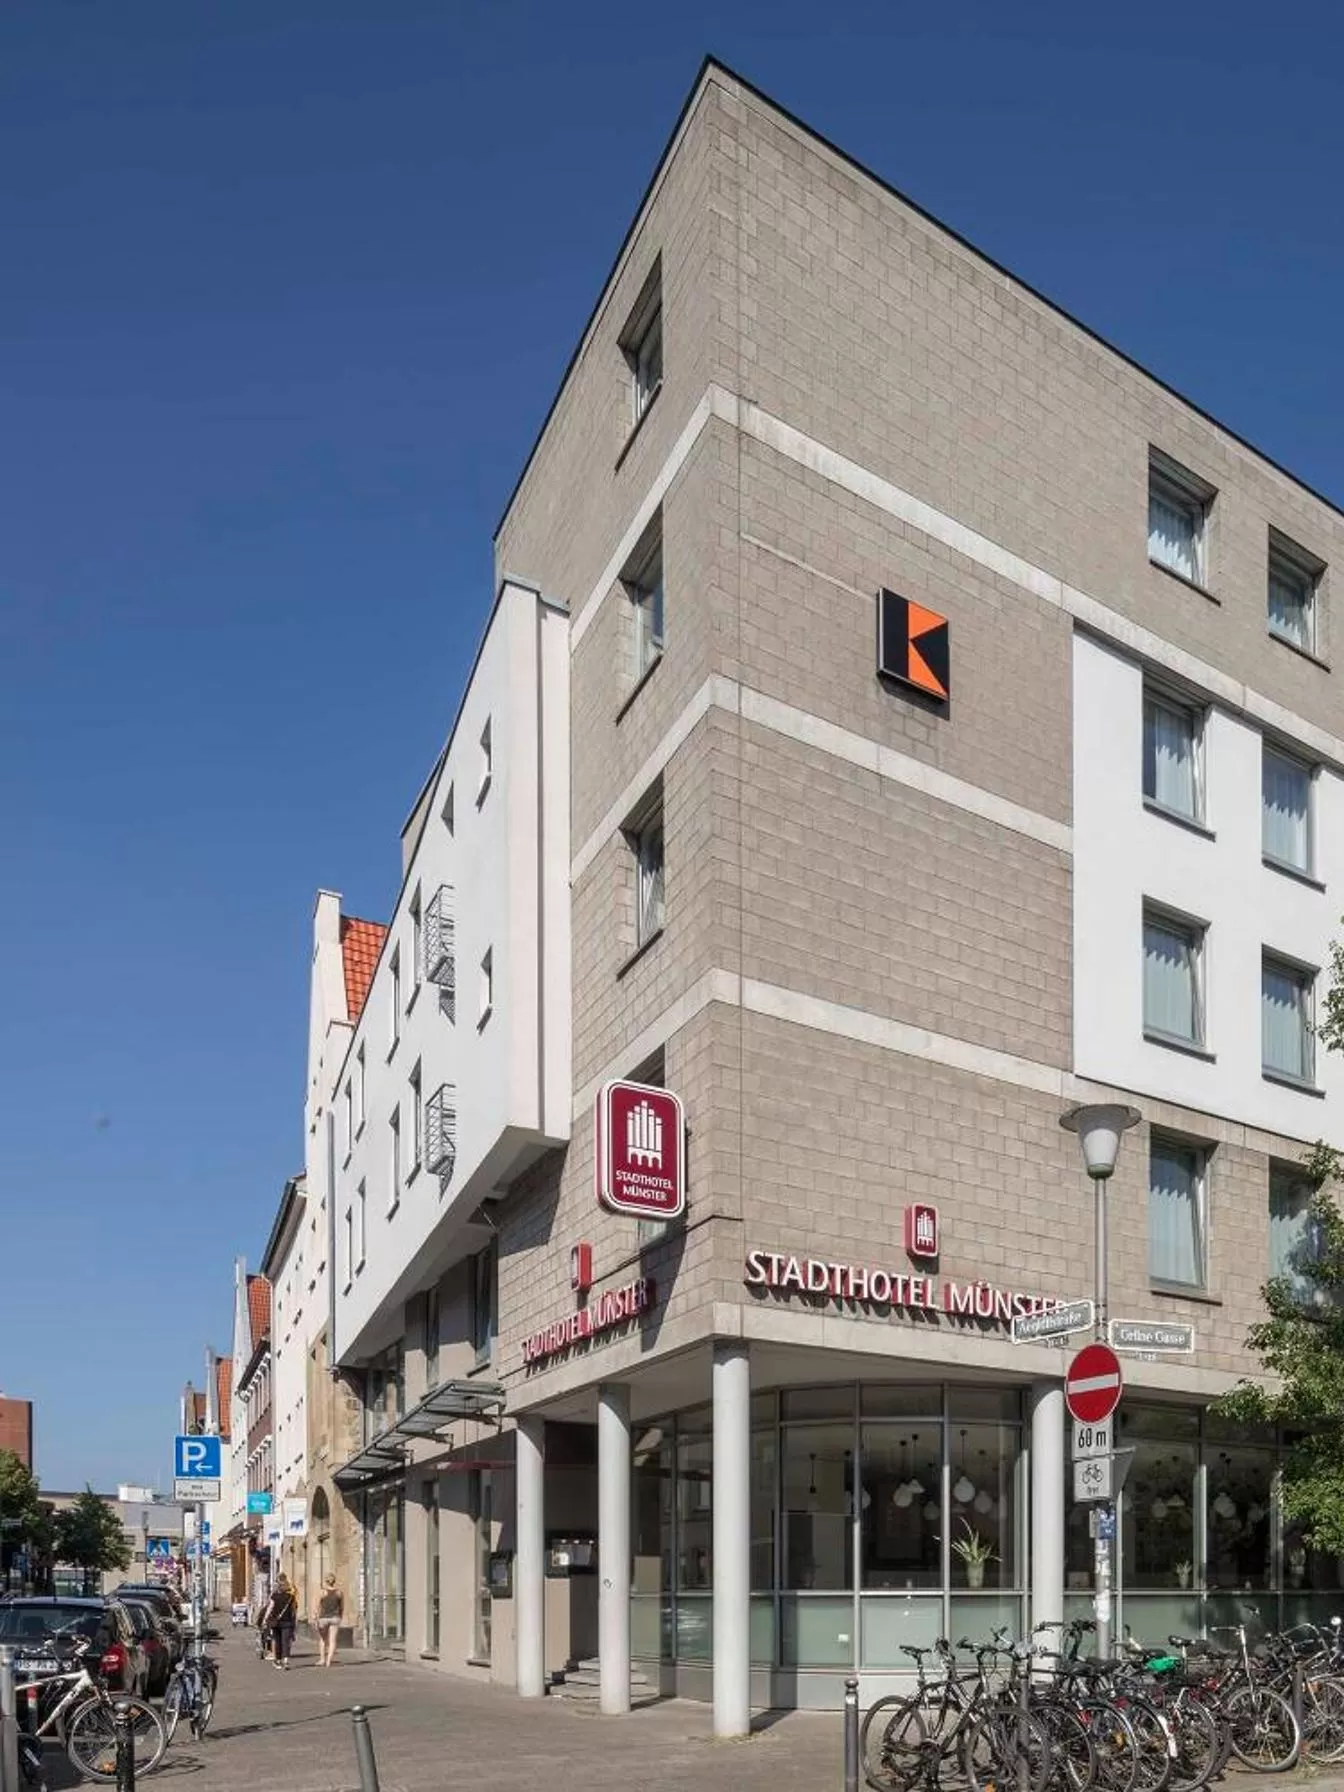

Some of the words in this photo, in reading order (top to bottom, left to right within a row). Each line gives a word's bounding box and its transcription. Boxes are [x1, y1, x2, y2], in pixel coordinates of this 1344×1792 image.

[615, 1169, 674, 1190] STADTHOTEL
[622, 1184, 668, 1201] MÜNSTER
[748, 1250, 939, 1310] STADTHOTEL
[1078, 1428, 1092, 1448] 60
[1096, 1431, 1107, 1447] m
[182, 1441, 207, 1472] P
